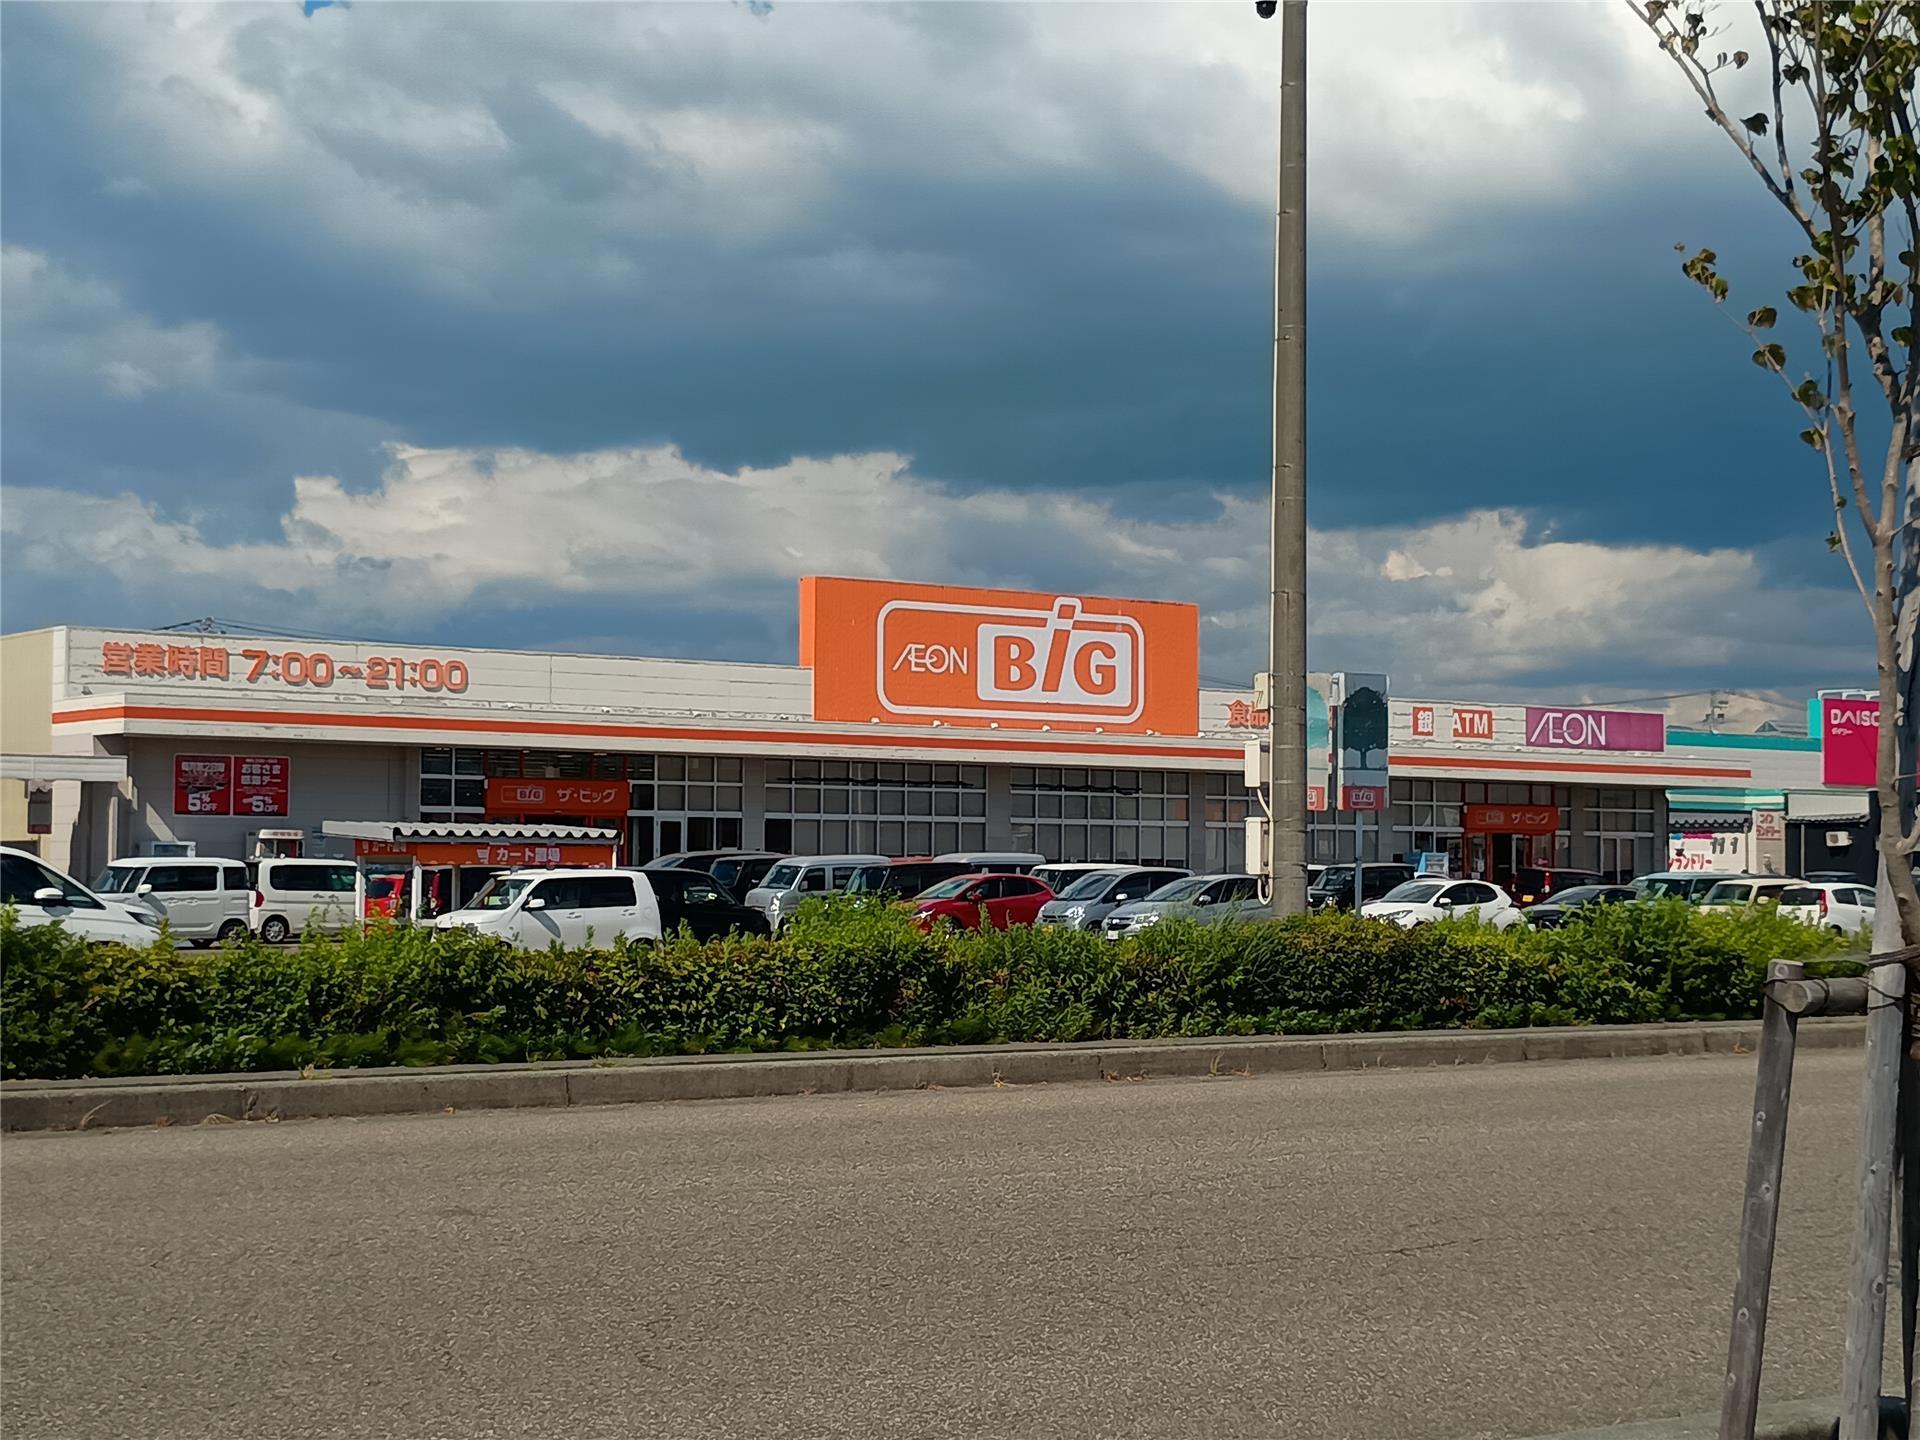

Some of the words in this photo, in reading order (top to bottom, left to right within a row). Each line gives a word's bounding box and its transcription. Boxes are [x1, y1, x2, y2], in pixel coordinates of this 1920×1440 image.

[102, 641, 230, 680] 営業時間
[1452, 712, 1488, 734] ATM
[556, 786, 618, 803] ザ・ビッグ
